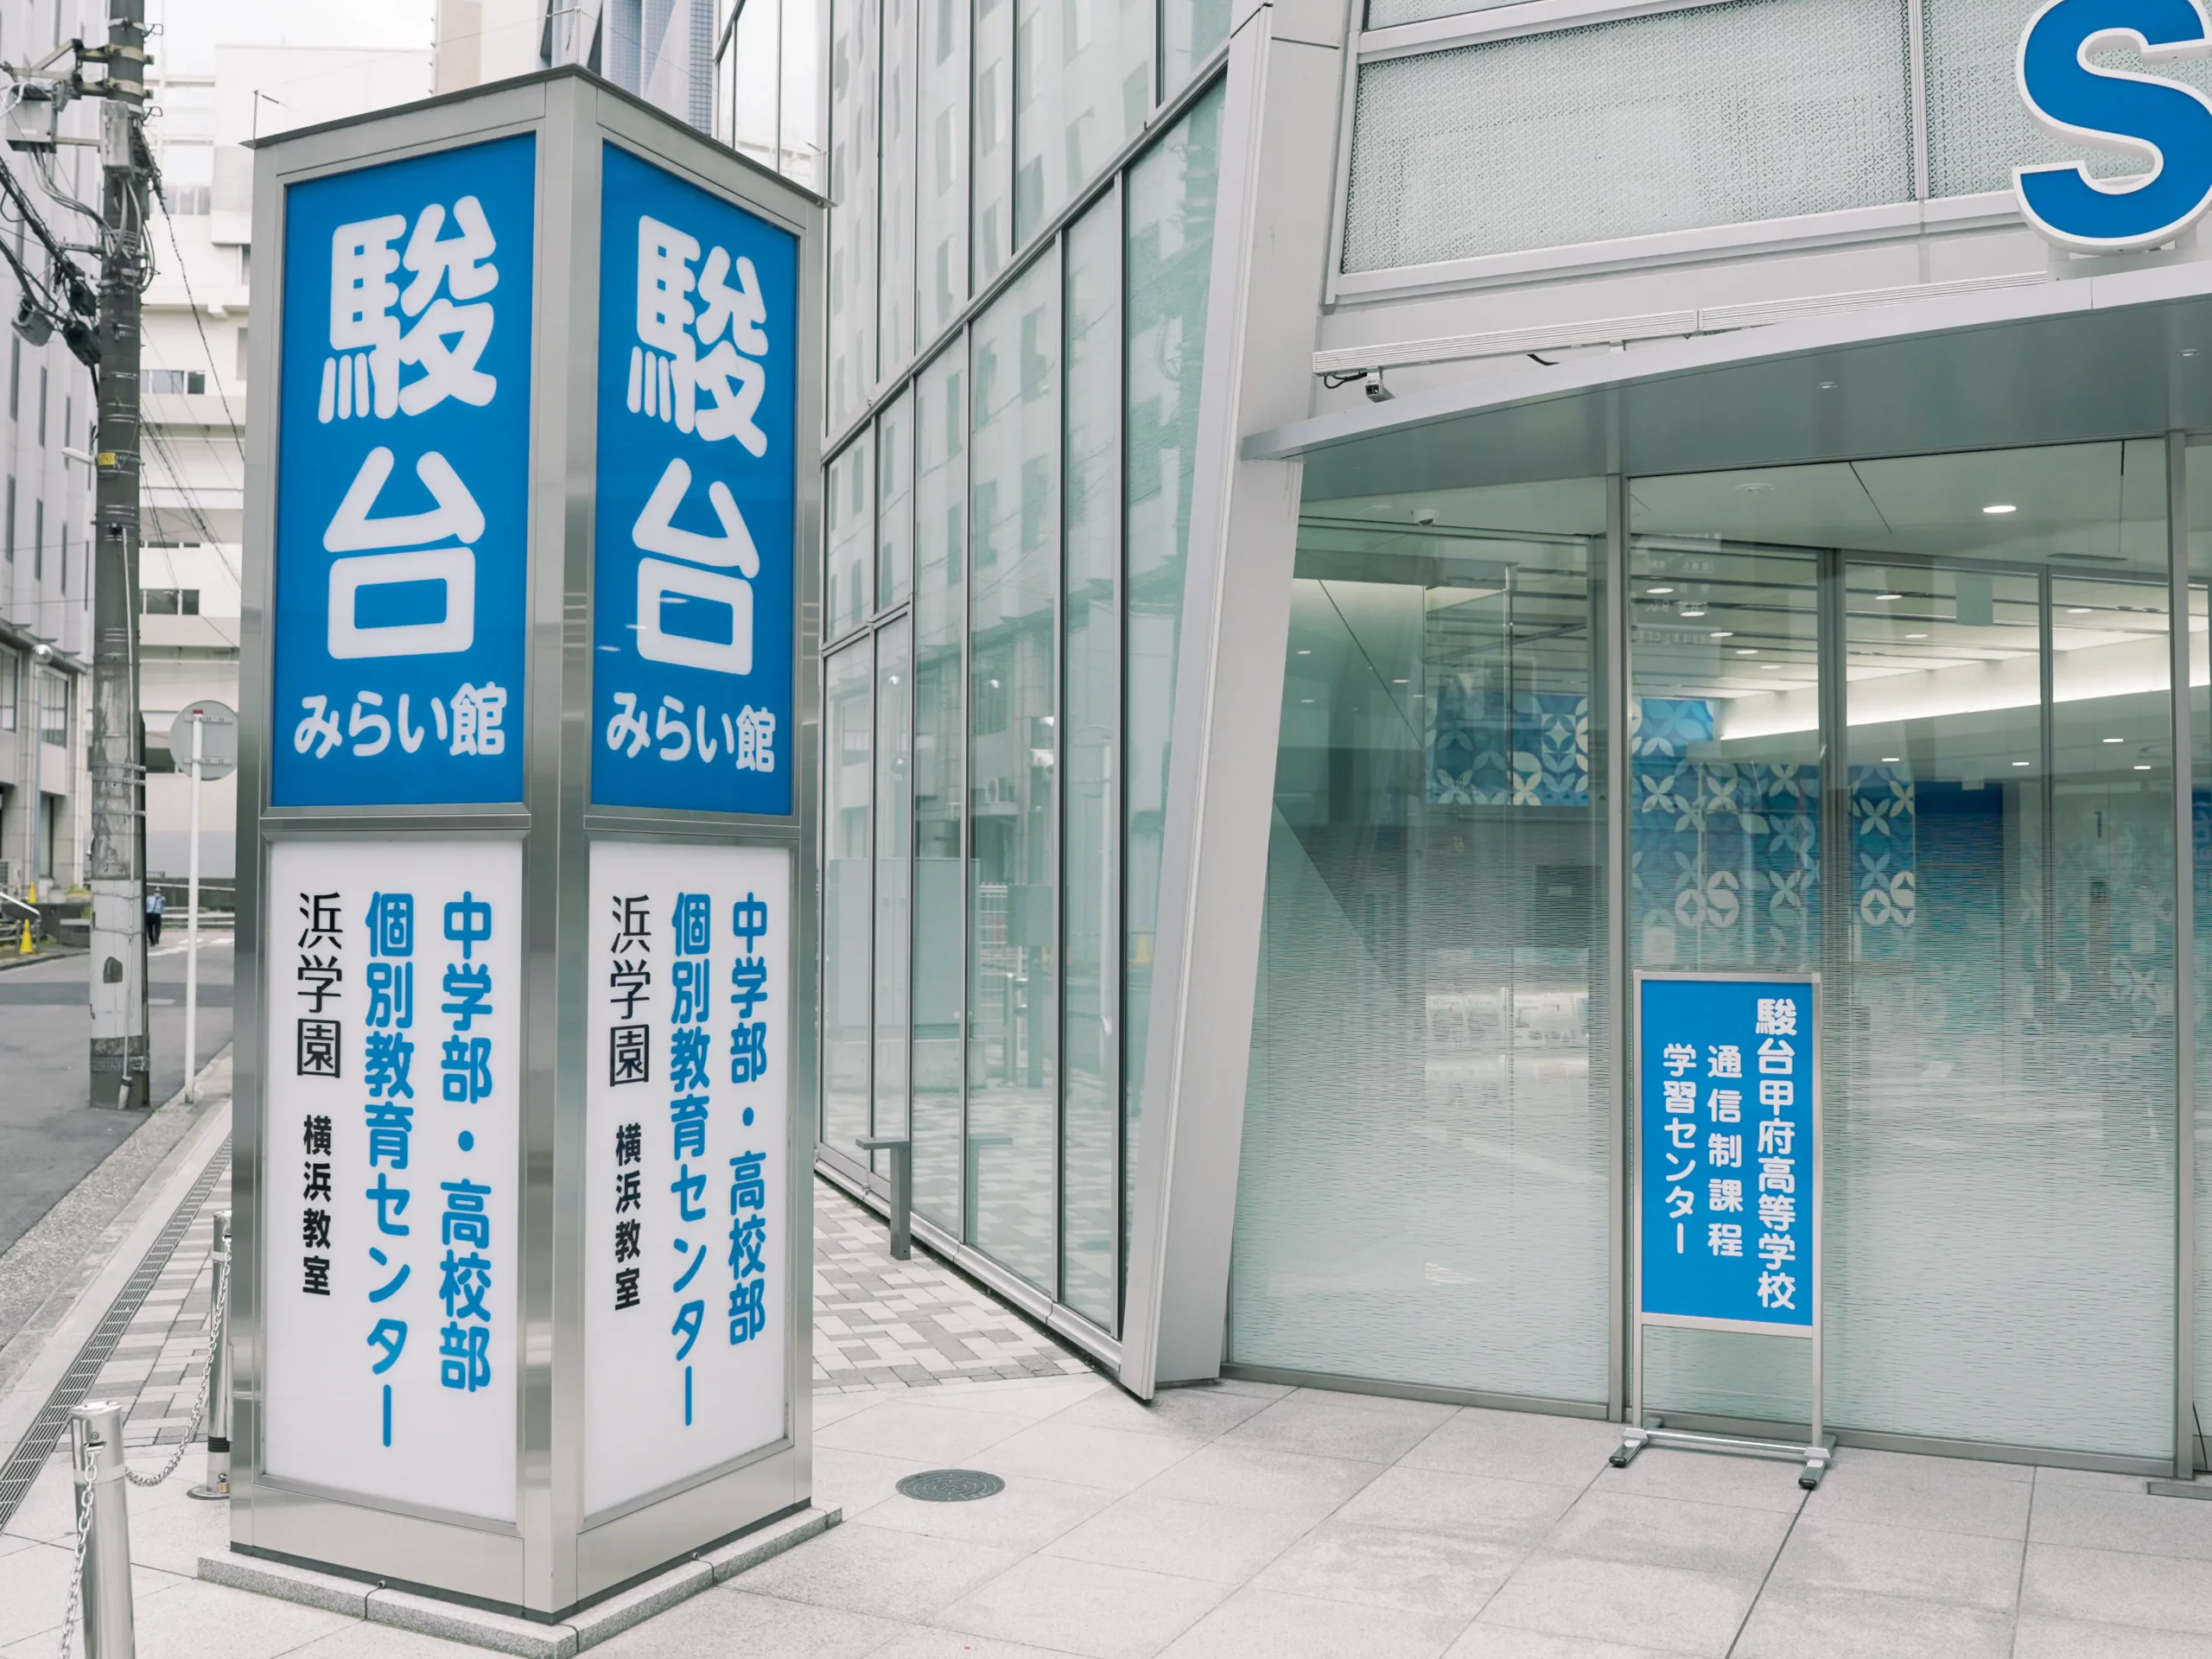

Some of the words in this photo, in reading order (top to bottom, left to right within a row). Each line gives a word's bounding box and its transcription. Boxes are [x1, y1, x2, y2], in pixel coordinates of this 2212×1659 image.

[2012, 0, 2212, 249] S
[318, 194, 499, 660] 駿台
[626, 213, 770, 676] 駿台
[294, 681, 507, 759] みらい館
[607, 692, 777, 772] みらい館
[296, 891, 343, 1079] 浜学園
[608, 893, 652, 1088] 浜学園
[302, 1114, 333, 1296] 横浜教室
[364, 890, 416, 1447] 個別教育センター
[438, 890, 493, 1393] 中学部・高校部
[614, 1122, 643, 1312] 横浜教室
[670, 891, 711, 1427] 個別教育センター
[728, 891, 769, 1346] 中学部・高校部
[1662, 1043, 1697, 1255] 学習センター
[1707, 1045, 1744, 1258] 通信制課程
[1755, 998, 1797, 1310] 駿台甲府高等学校
